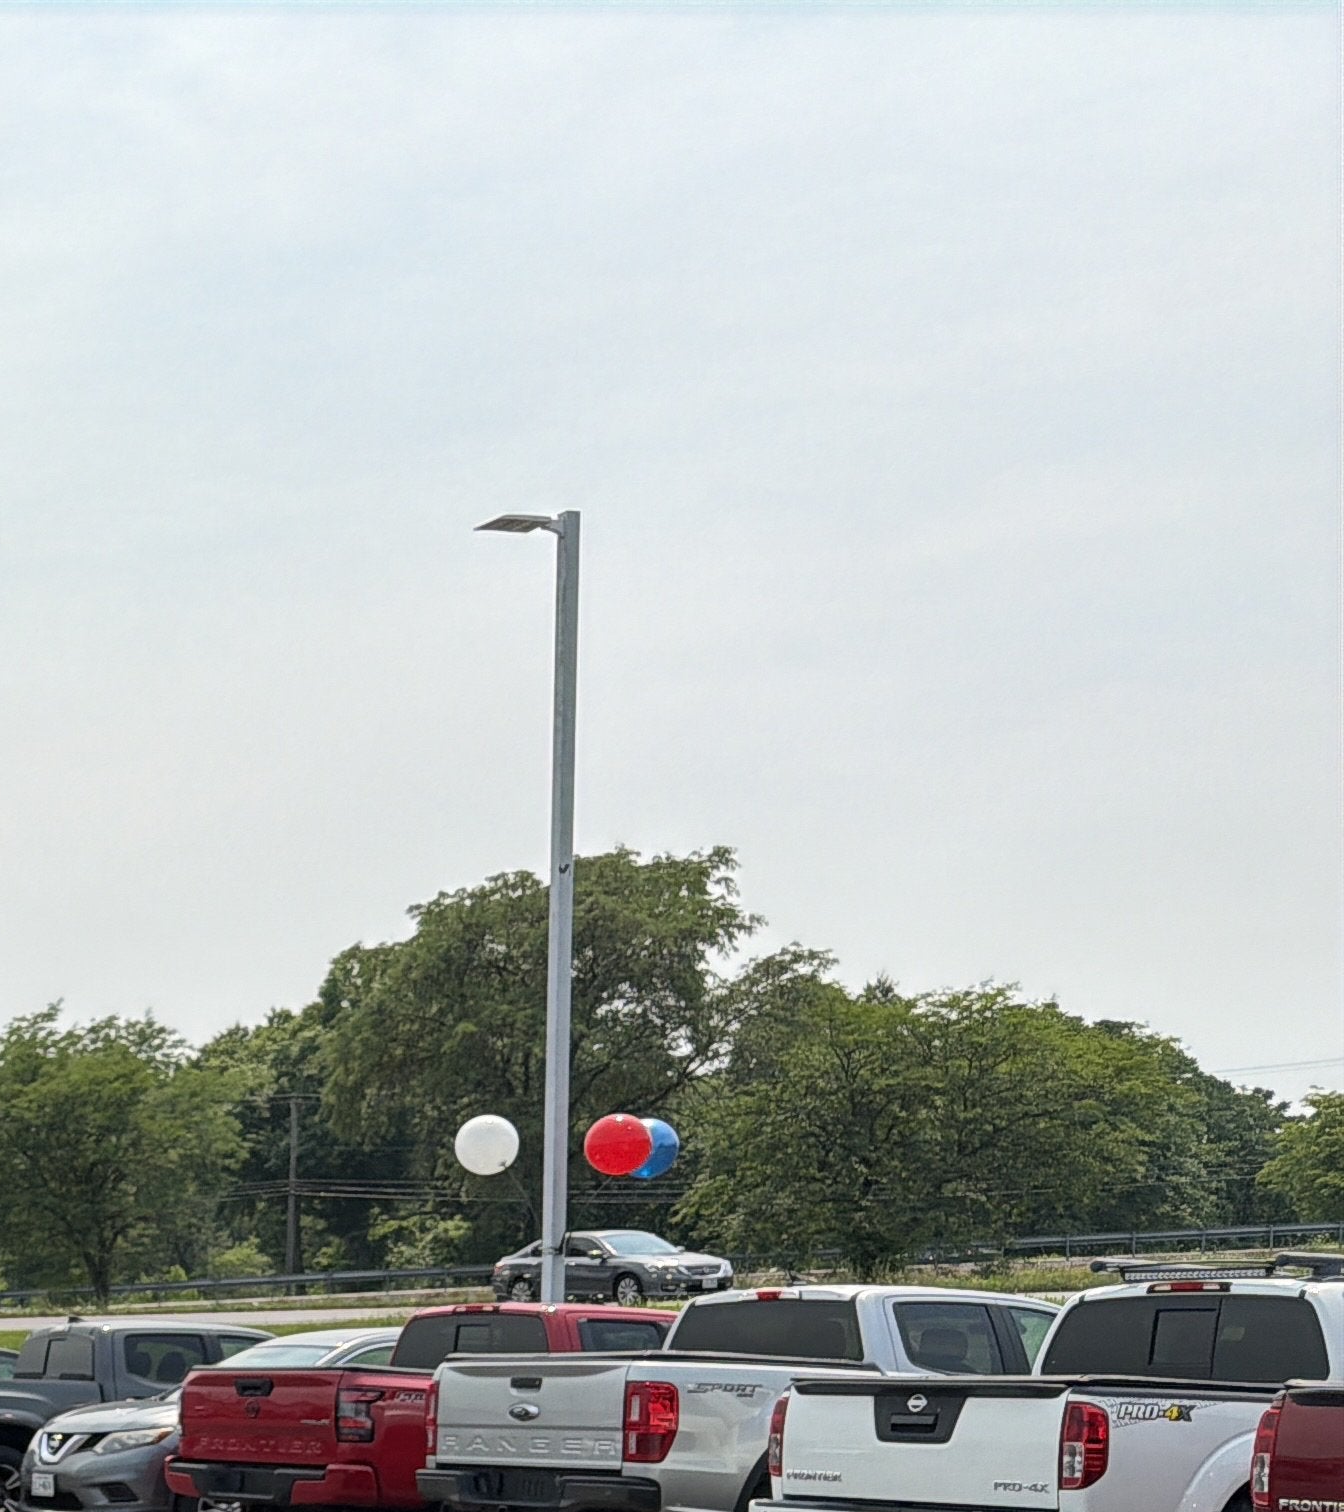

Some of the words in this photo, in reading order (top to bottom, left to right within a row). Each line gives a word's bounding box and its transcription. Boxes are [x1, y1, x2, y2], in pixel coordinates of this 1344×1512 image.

[687, 1382, 763, 1394] SPORT
[1117, 1401, 1197, 1422] PRO-4X
[441, 1434, 616, 1456] RANGER
